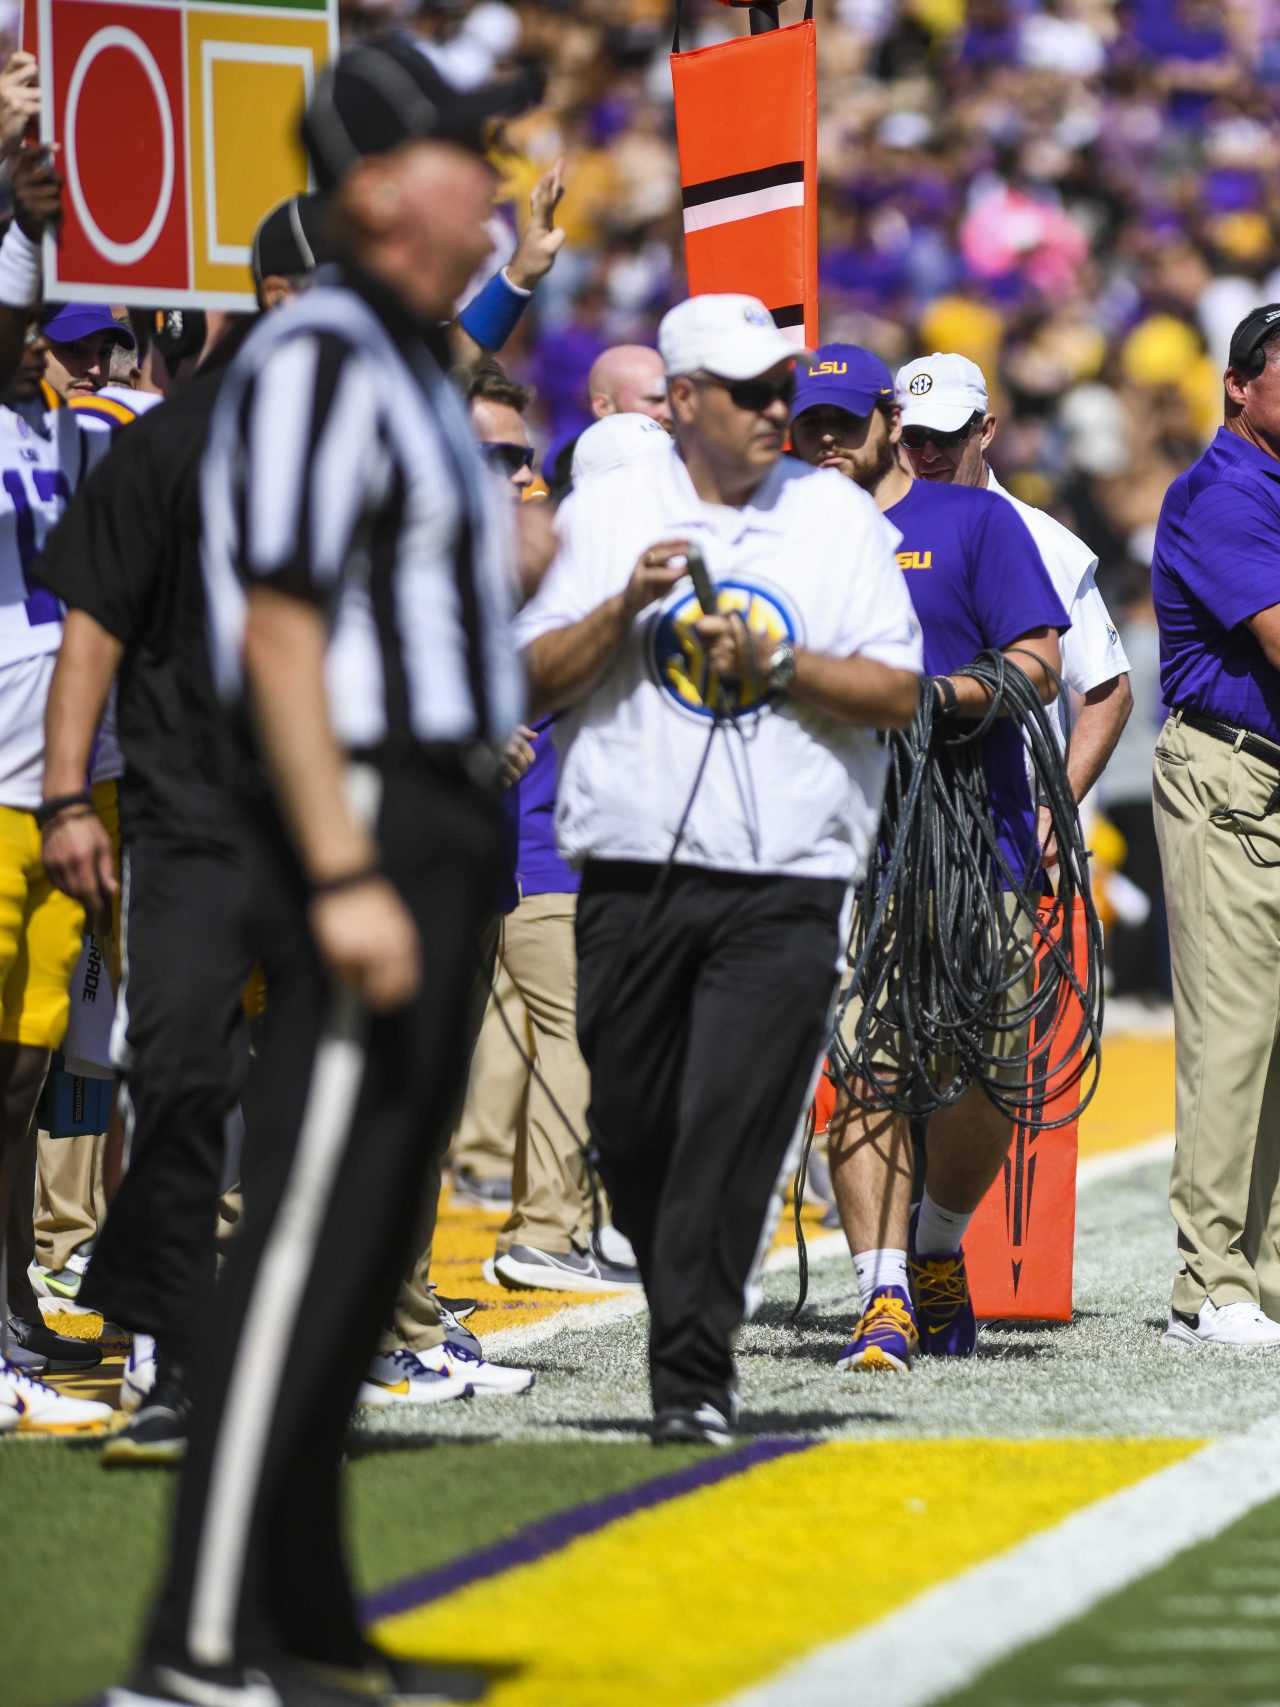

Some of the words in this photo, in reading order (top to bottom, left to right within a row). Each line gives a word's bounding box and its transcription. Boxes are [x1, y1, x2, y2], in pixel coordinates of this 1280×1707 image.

[808, 361, 847, 376] LSU
[910, 374, 932, 395] SEC
[895, 550, 932, 570] SU
[83, 934, 101, 1002] RADE
